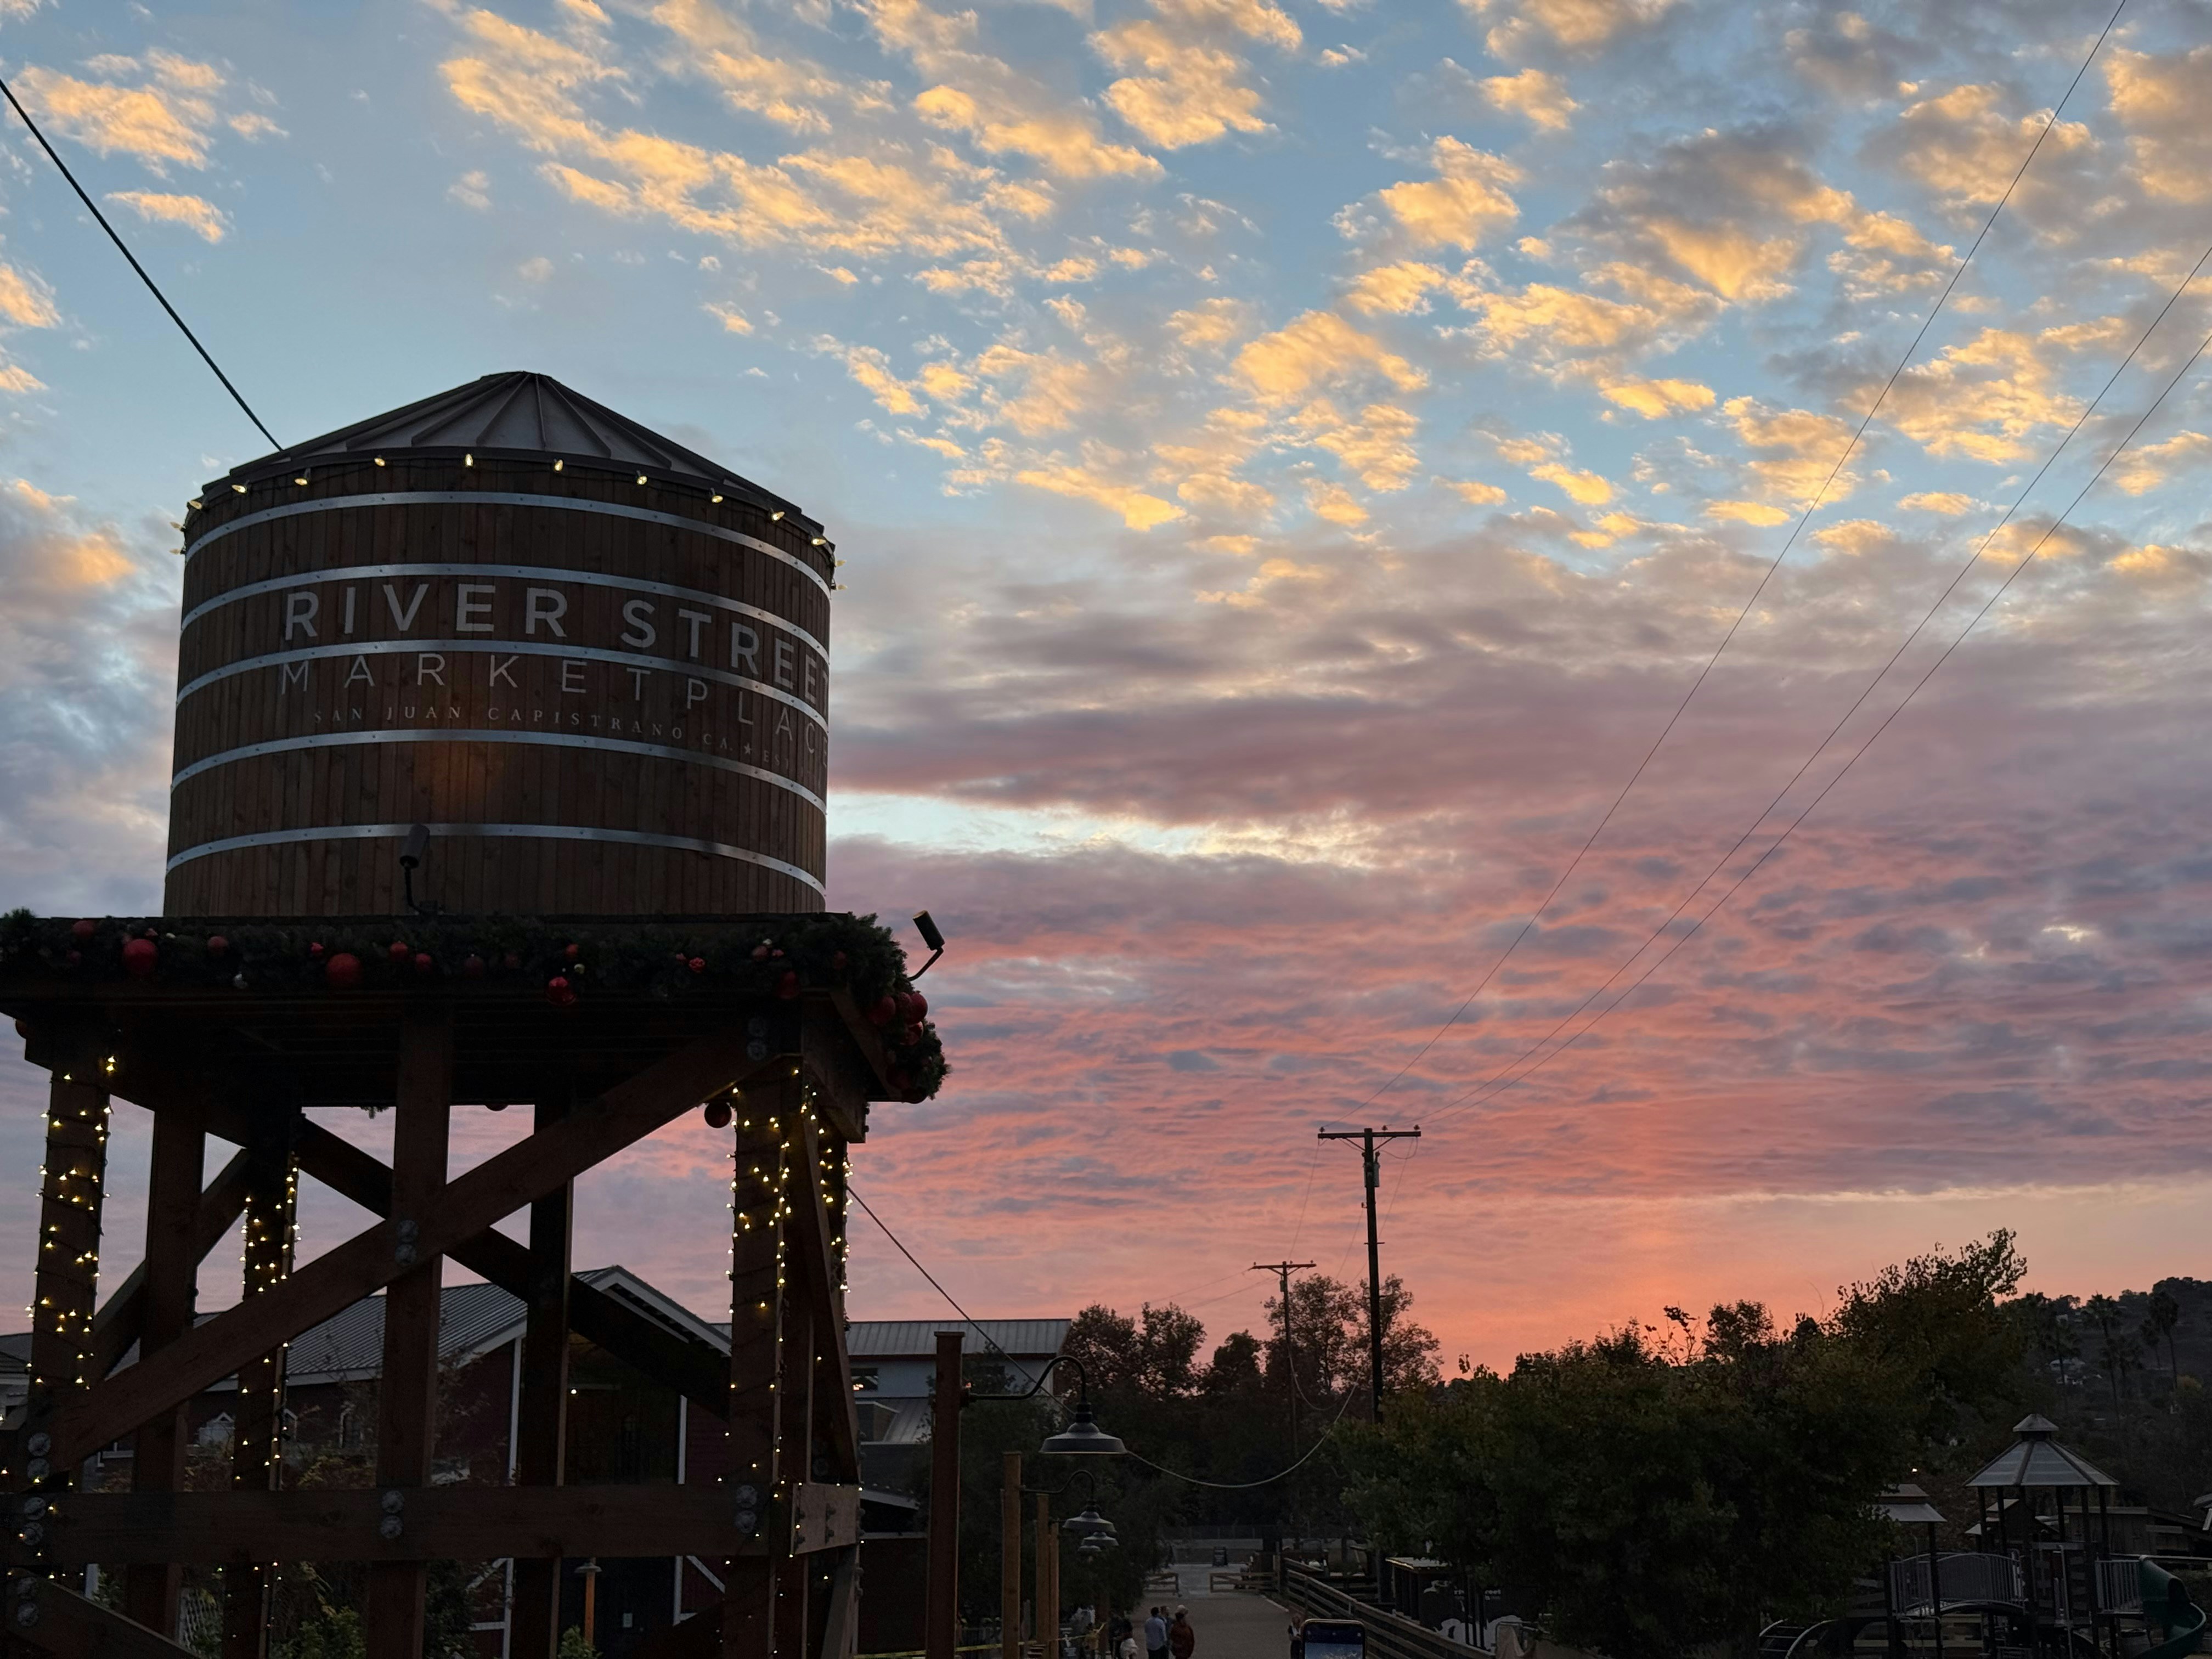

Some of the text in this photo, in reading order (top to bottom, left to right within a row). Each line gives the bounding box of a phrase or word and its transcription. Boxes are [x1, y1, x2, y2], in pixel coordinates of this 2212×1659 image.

[285, 584, 567, 641] RIVER
[314, 708, 362, 724] SAN
[387, 706, 460, 720] JUAN
[488, 708, 682, 739] CAPISTRANO
